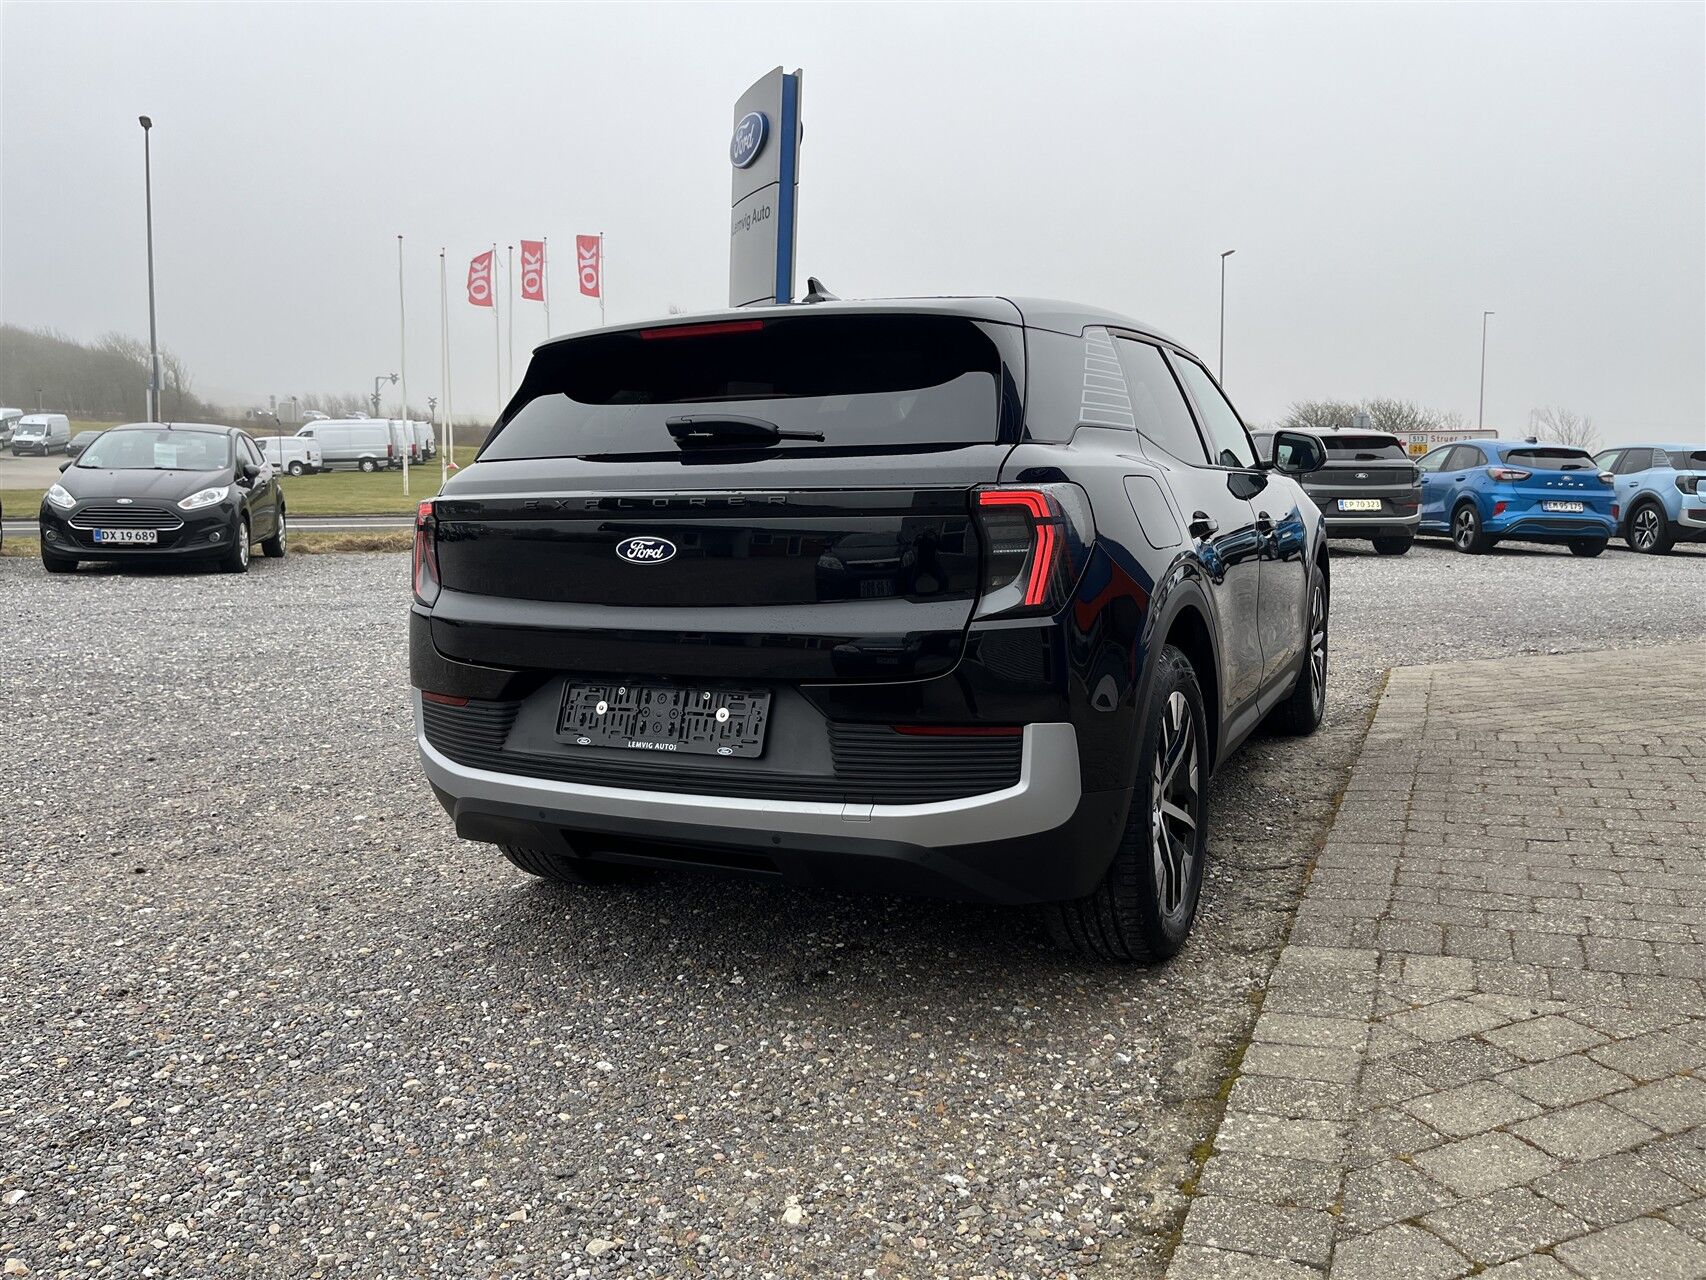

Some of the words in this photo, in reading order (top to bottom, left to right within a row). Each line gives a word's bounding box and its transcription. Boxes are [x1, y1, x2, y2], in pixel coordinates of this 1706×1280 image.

[733, 120, 754, 159] Ford
[752, 205, 771, 224] Auto
[524, 251, 542, 293] OK
[579, 245, 598, 289] OK
[470, 259, 489, 300] OK
[1430, 435, 1458, 443] Struer
[524, 496, 787, 510] EXPLORER
[102, 531, 117, 541] DX
[120, 531, 133, 541] 19
[135, 531, 155, 541] 689
[627, 540, 664, 559] Ford
[628, 741, 653, 749] LEMVIG
